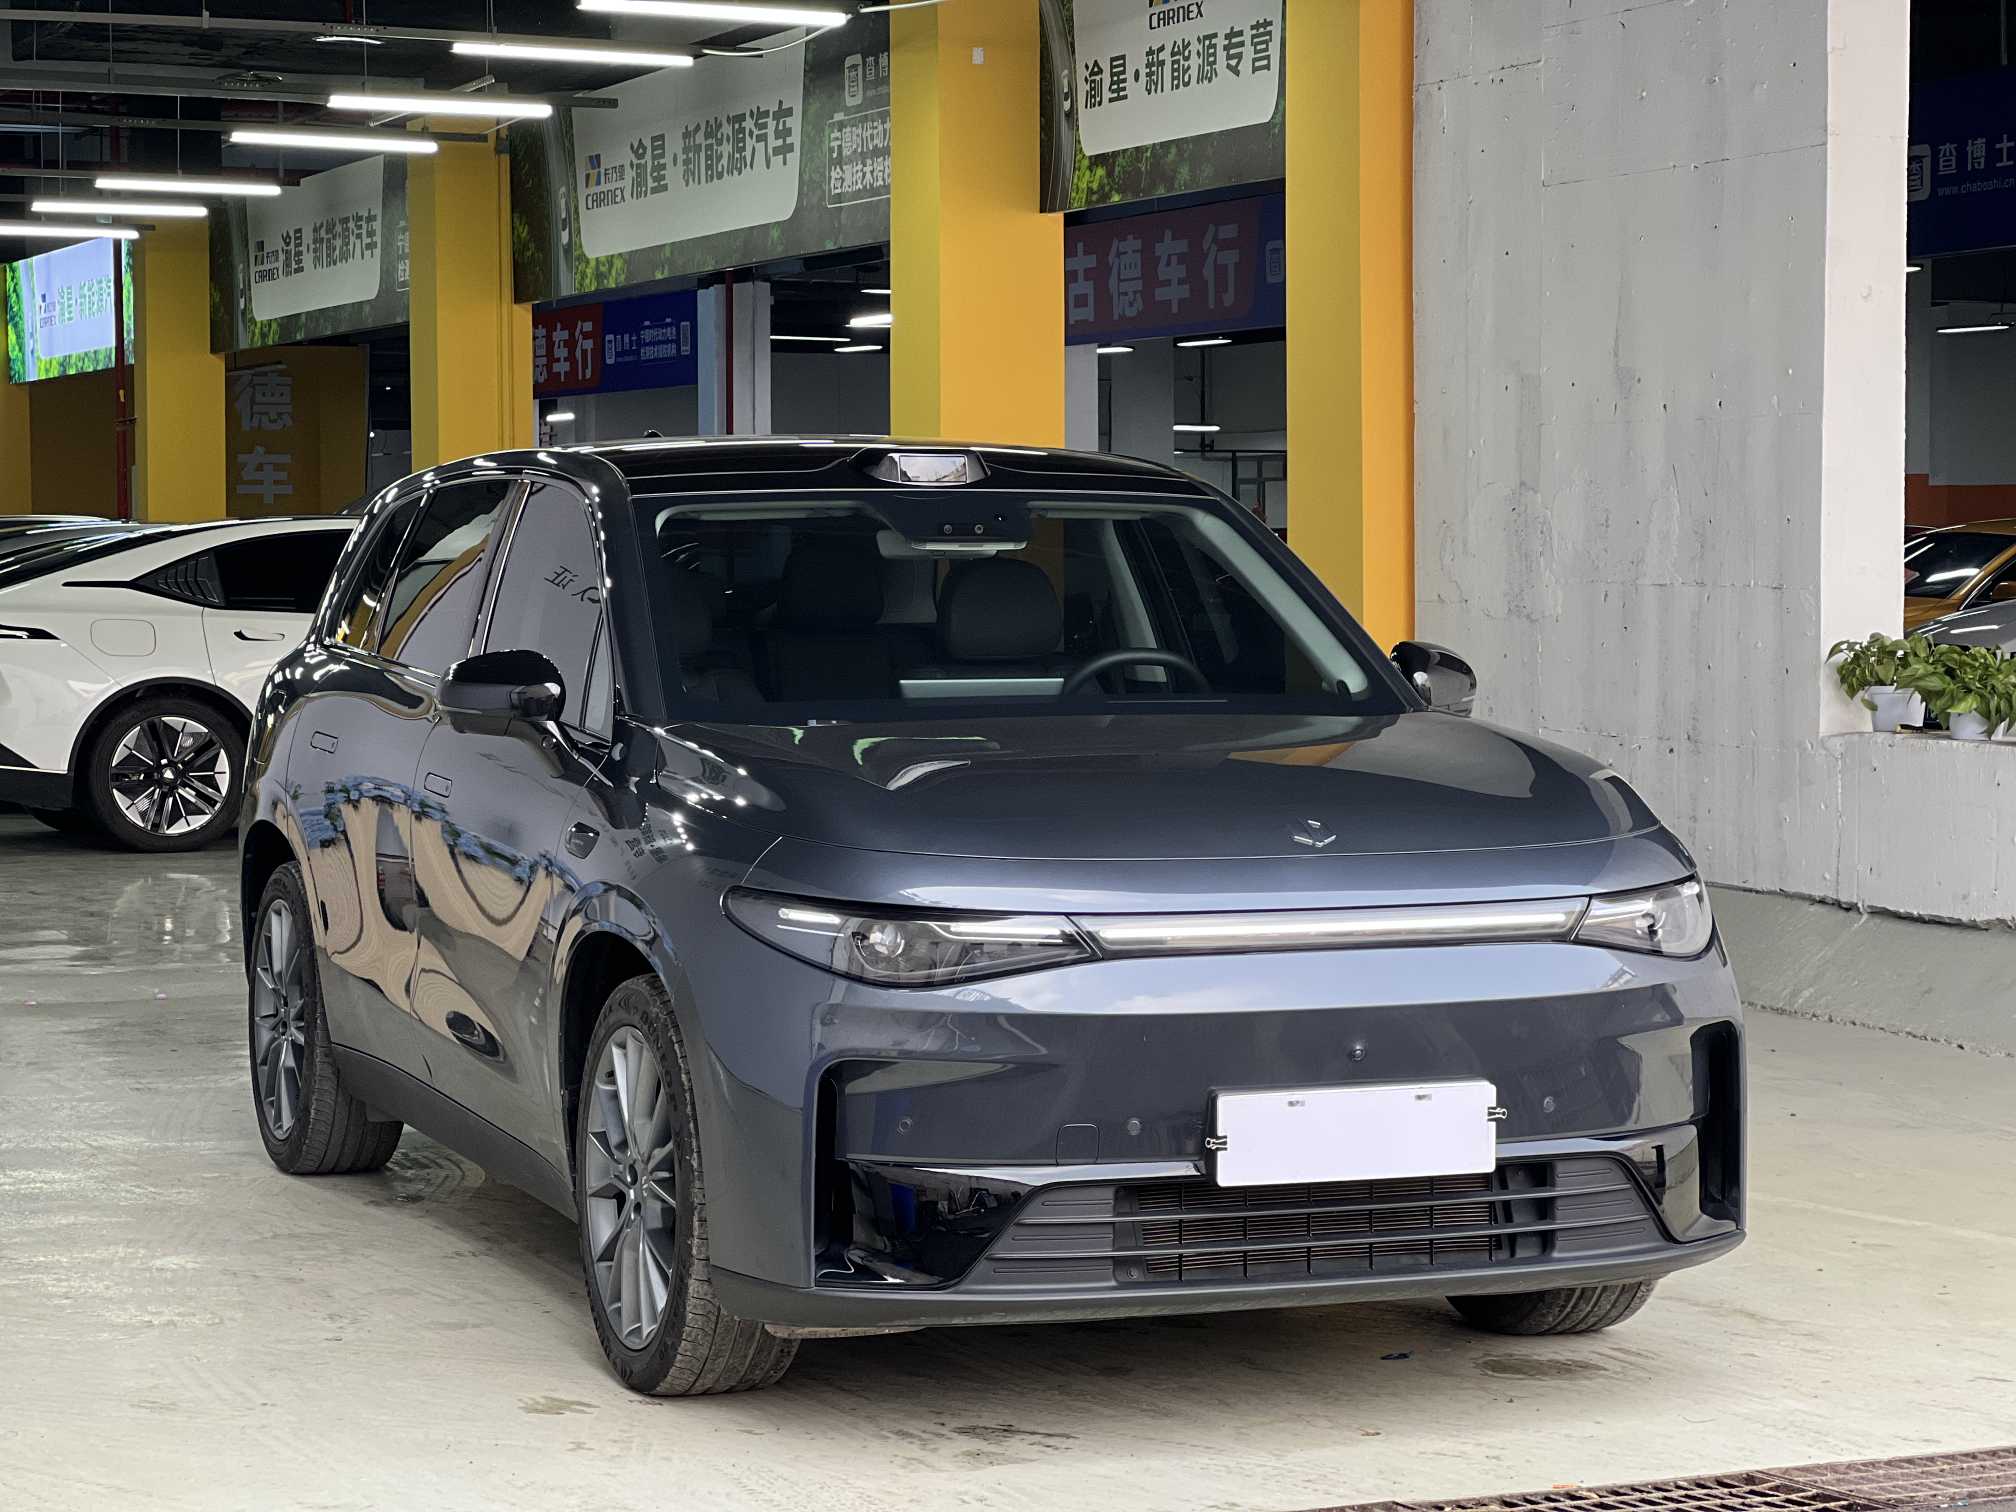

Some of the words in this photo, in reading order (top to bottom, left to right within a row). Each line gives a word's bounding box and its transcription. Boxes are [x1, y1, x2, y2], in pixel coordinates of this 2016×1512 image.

[1149, 1, 1204, 30] CARNEX
[1084, 18, 1273, 109] 渝星·新能源专营
[630, 99, 794, 200] 渝星·新能源汽车
[1936, 133, 2016, 175] 查博士
[585, 187, 626, 210] CARNEX
[282, 207, 377, 278] 渝星·新能源汽车
